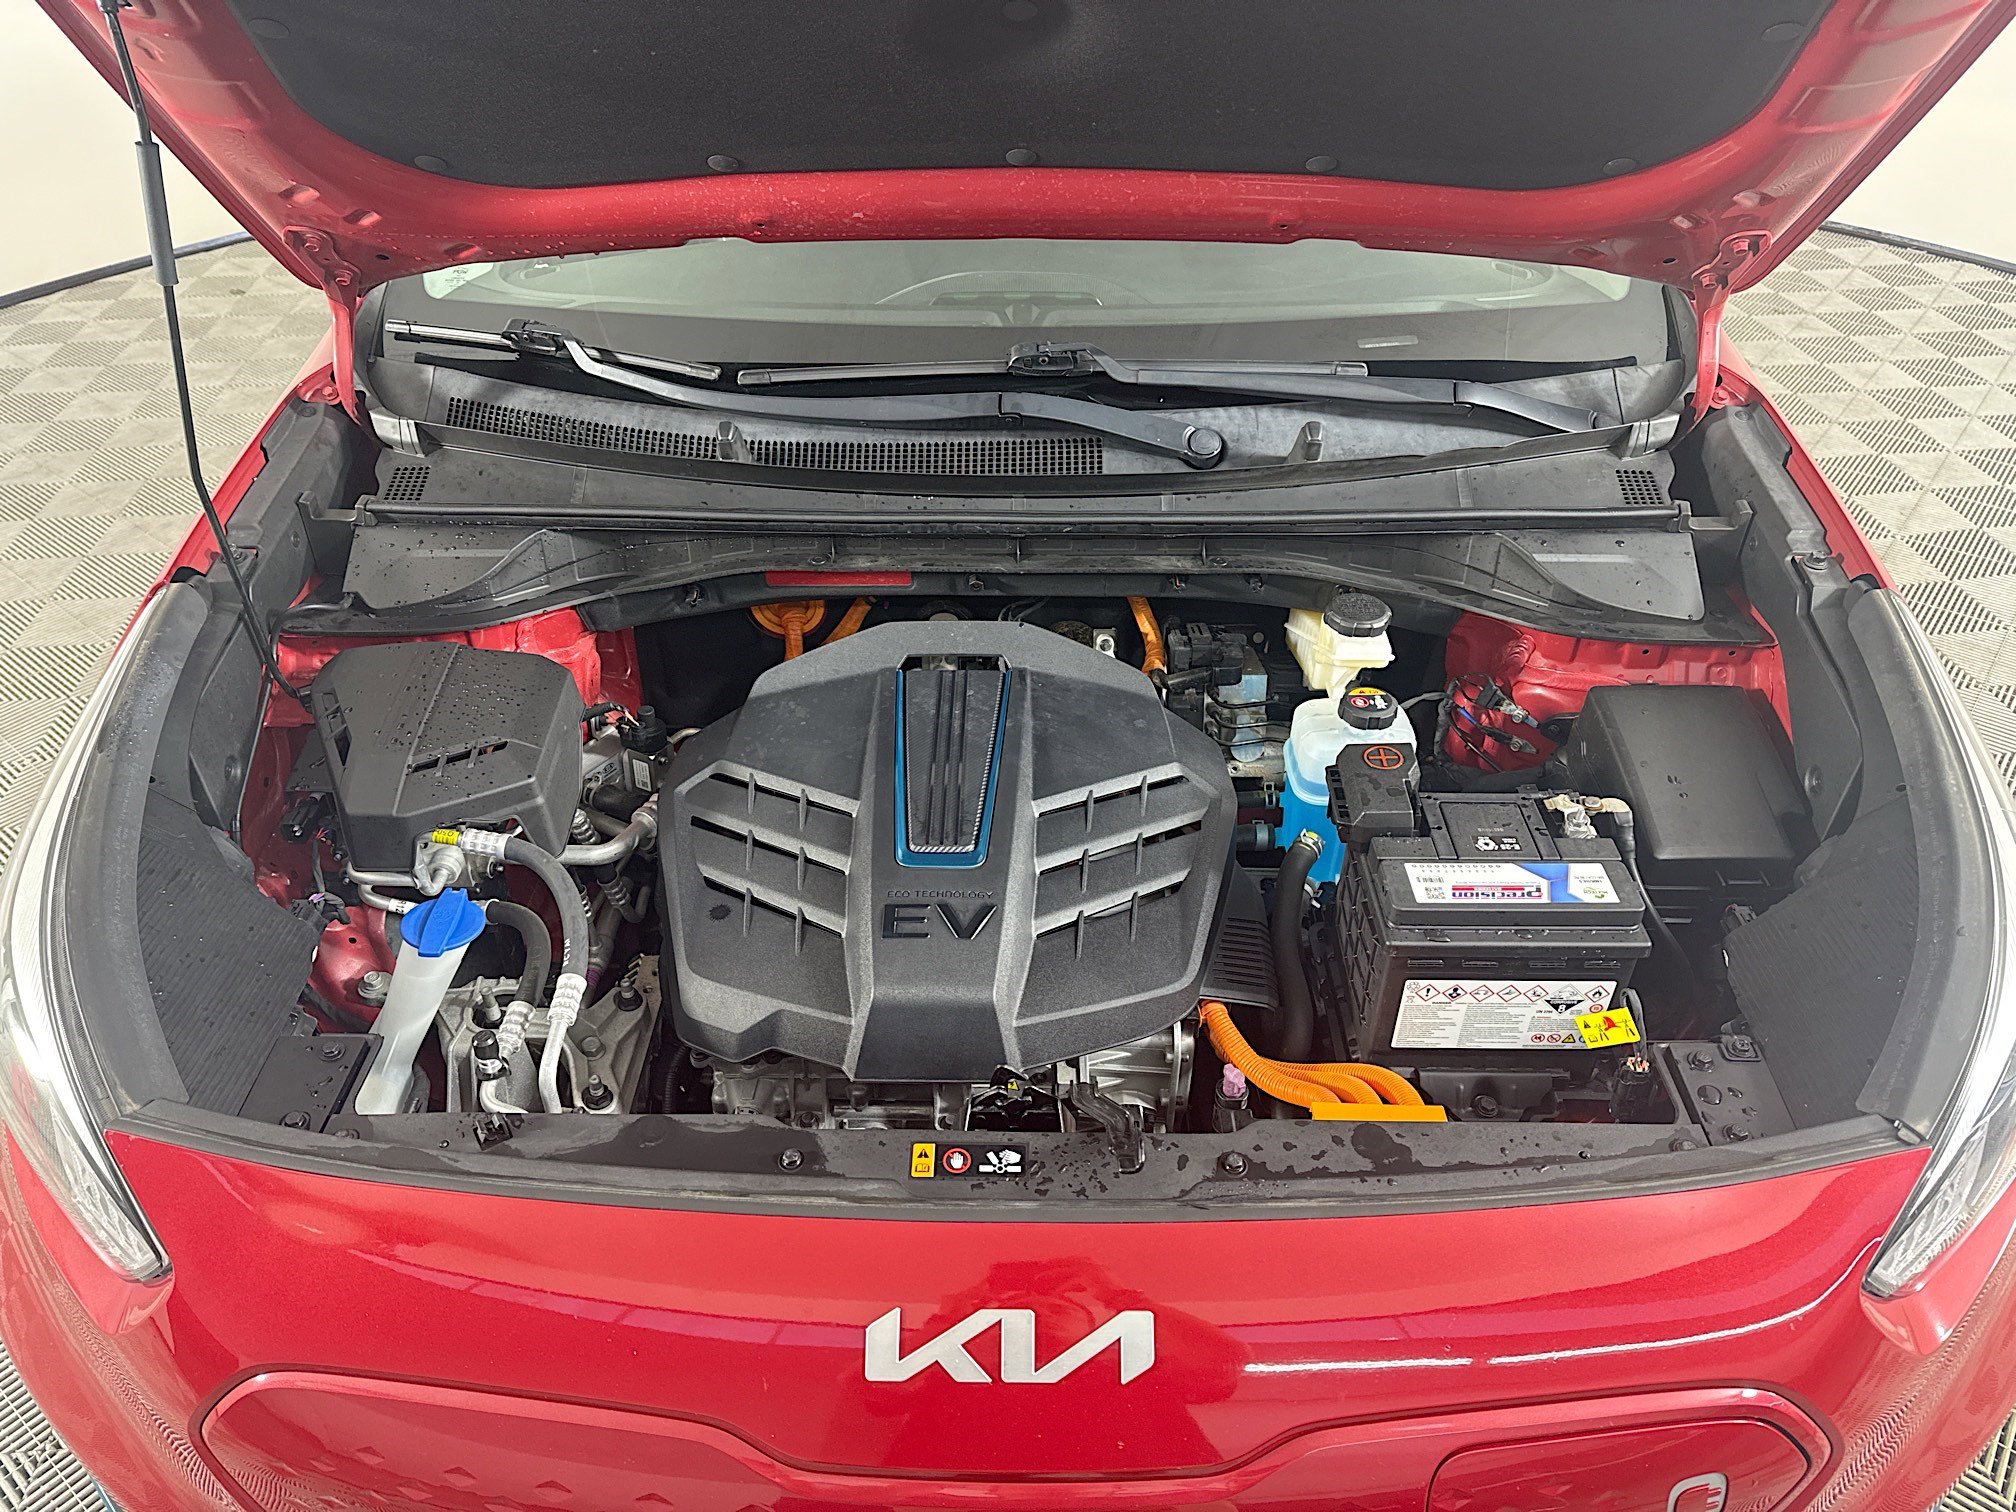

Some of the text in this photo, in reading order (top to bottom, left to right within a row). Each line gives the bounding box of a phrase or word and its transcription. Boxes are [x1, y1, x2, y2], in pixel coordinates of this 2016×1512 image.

[887, 890, 994, 899] ECO TECHNOLOGY
[1452, 886, 1543, 899] precision
[881, 903, 998, 939] EV
[1557, 1004, 1566, 1012] 8
[865, 1307, 1155, 1385] KIA
